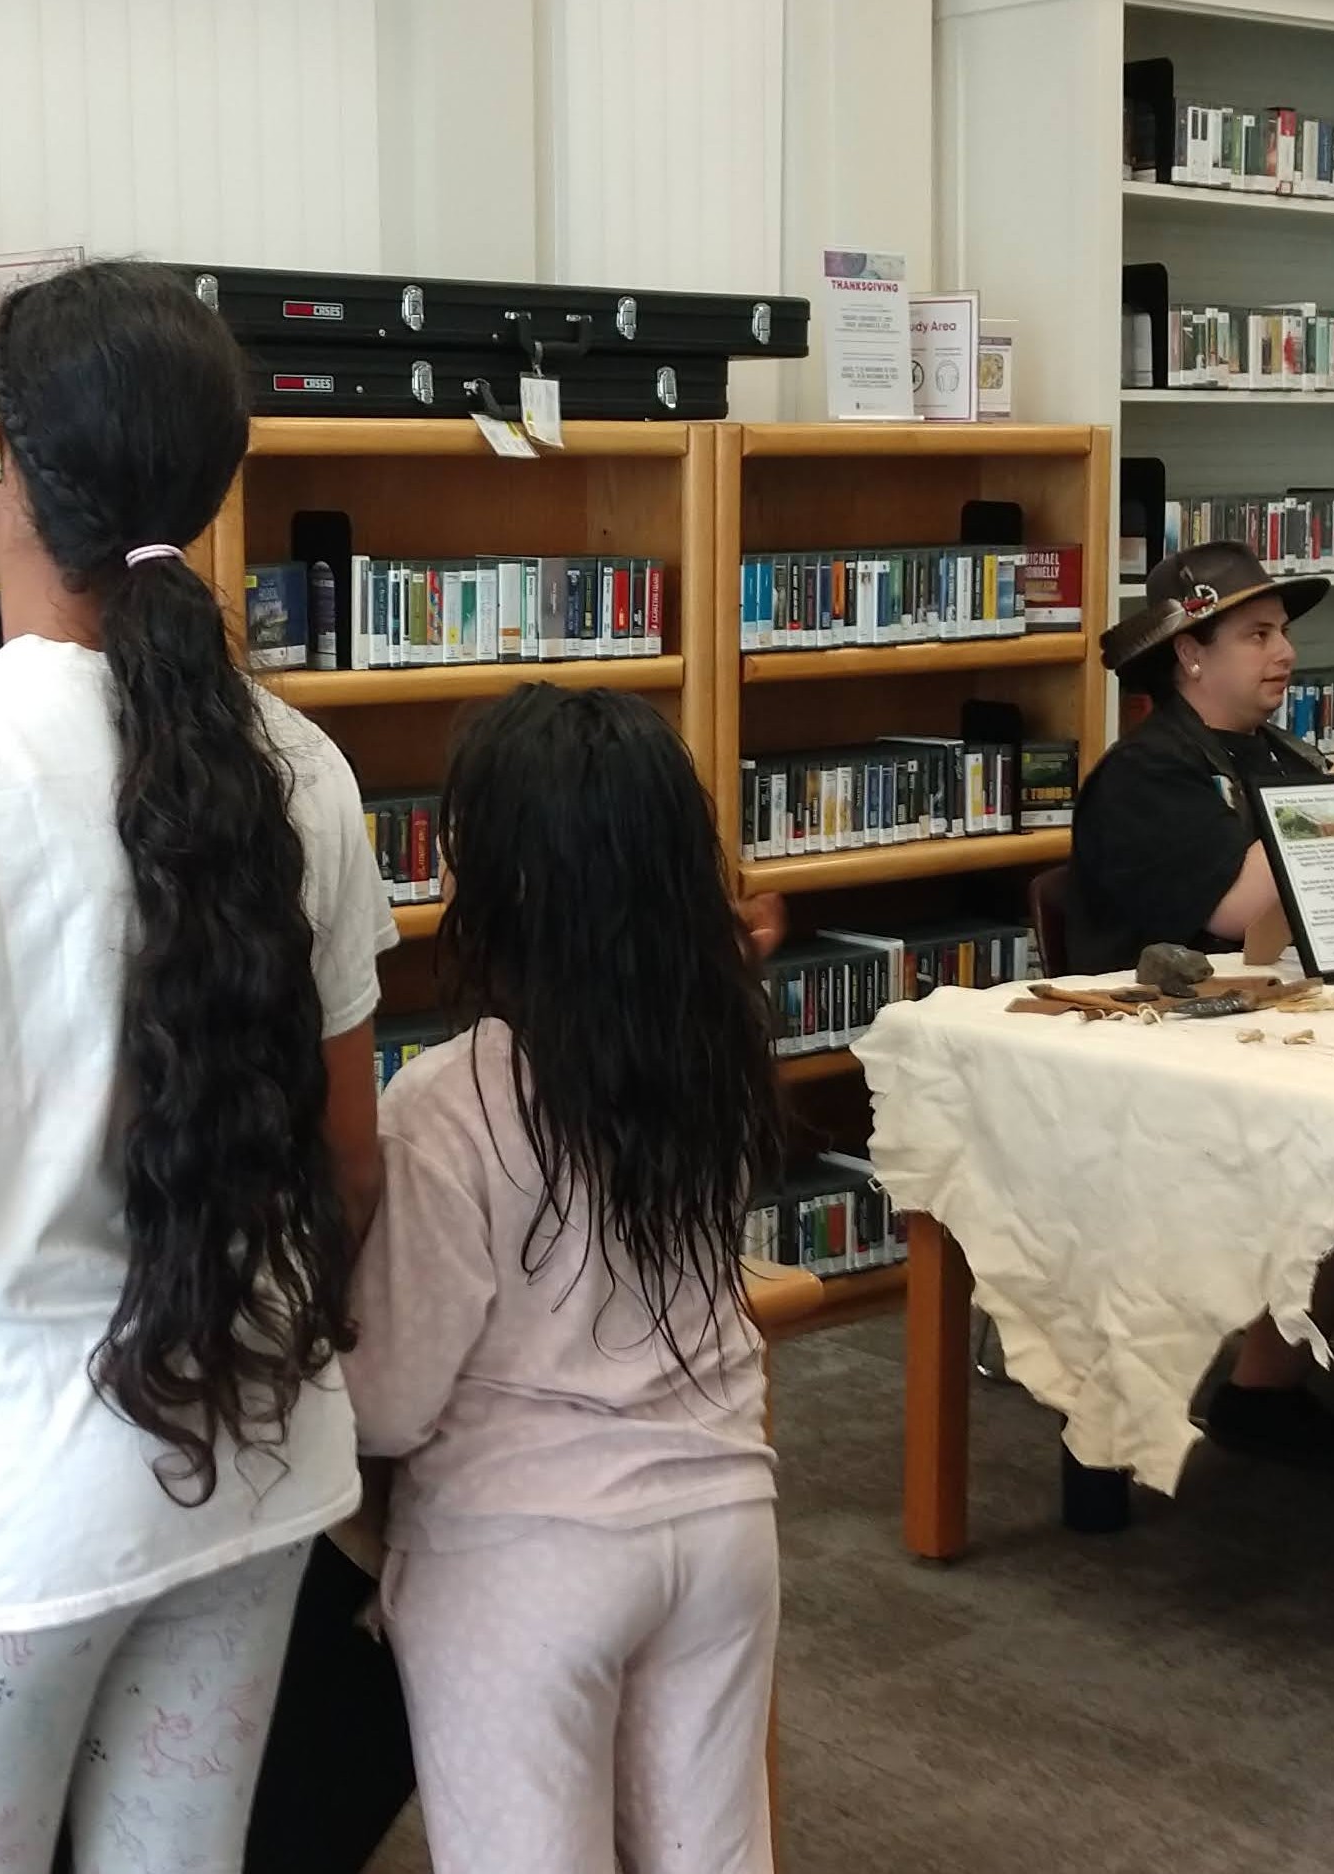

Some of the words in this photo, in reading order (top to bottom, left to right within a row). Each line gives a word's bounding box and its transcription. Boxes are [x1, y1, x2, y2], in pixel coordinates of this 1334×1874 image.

[831, 280, 899, 293] THANKSGIVING
[313, 305, 341, 317] CASES
[910, 321, 927, 333] udy
[931, 321, 956, 331] Area
[304, 378, 332, 390] CASES
